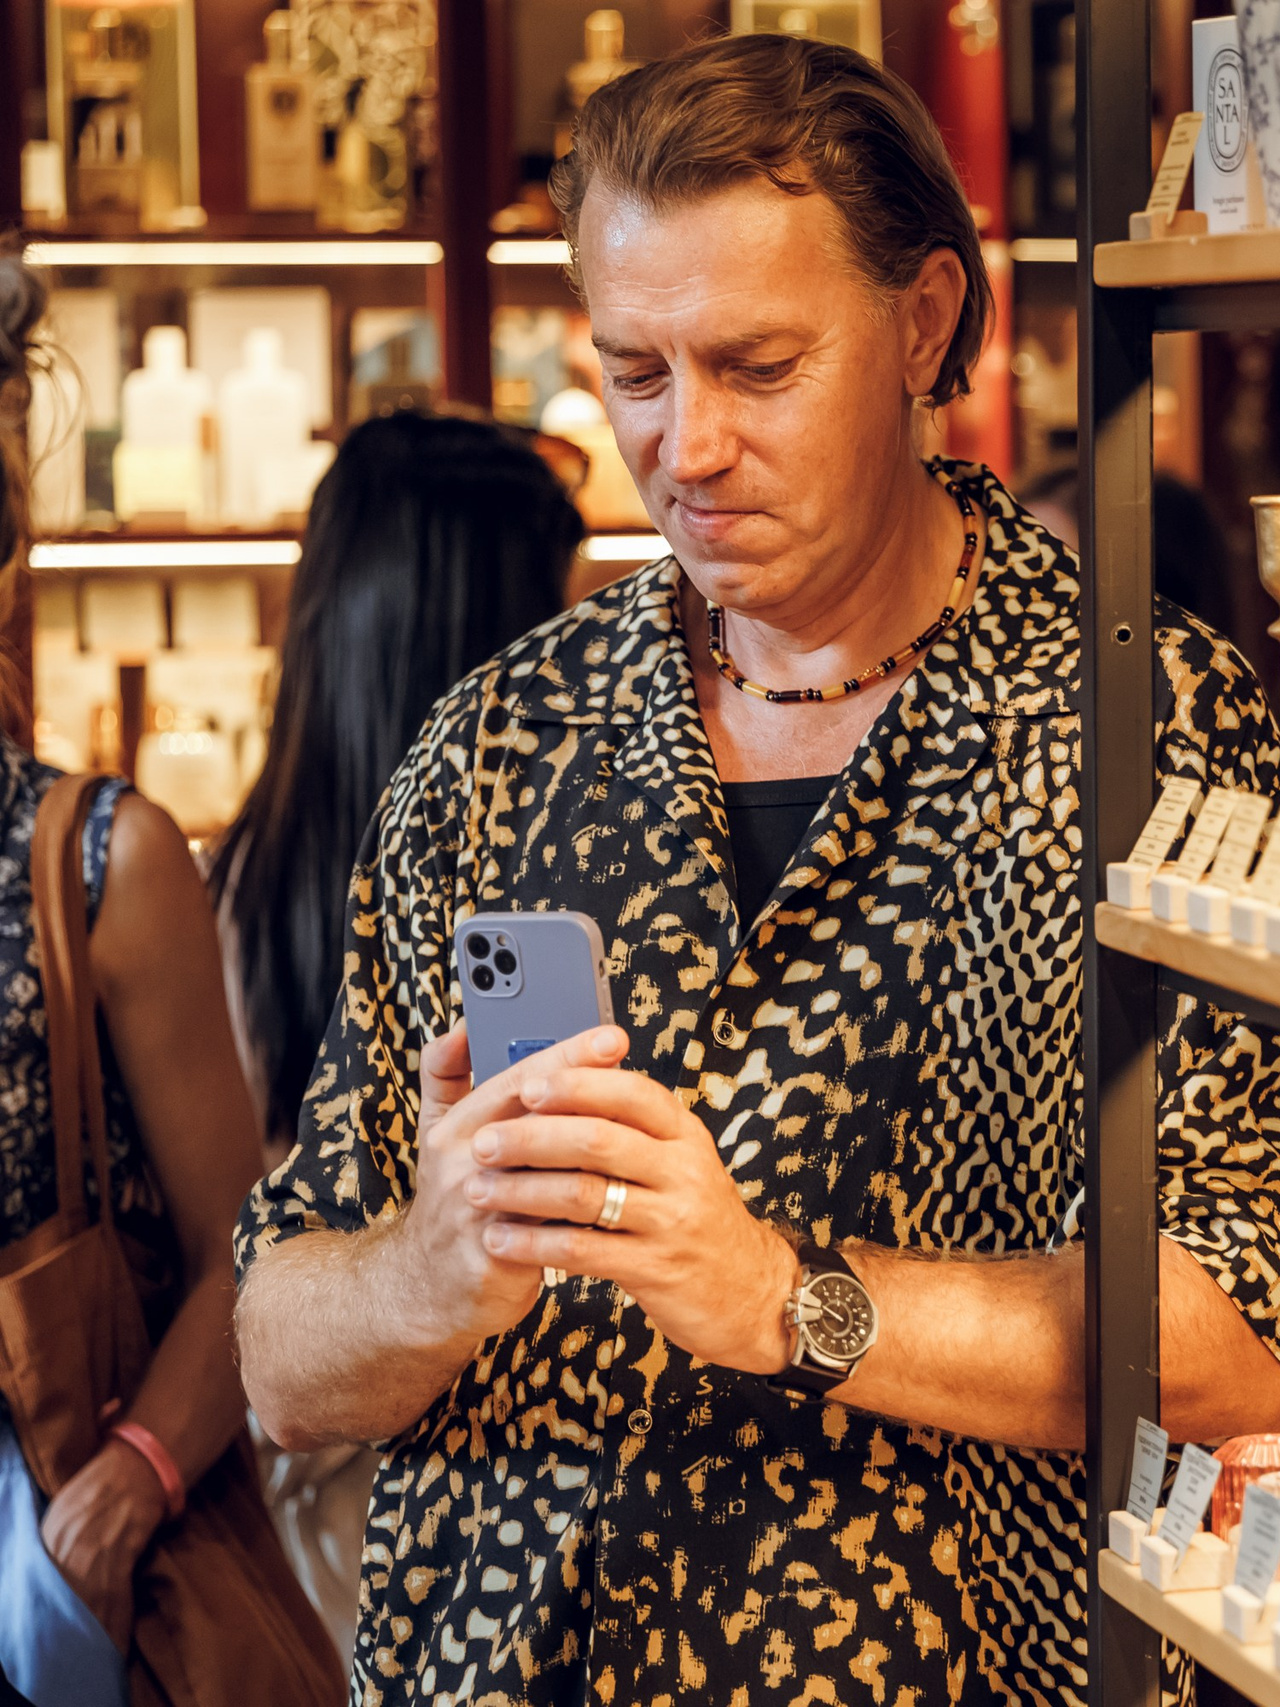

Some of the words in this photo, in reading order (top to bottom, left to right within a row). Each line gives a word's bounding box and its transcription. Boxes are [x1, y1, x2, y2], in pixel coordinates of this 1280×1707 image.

[1218, 77, 1236, 99] SA
[1216, 103, 1240, 123] NTA
[1224, 126, 1231, 145] L
